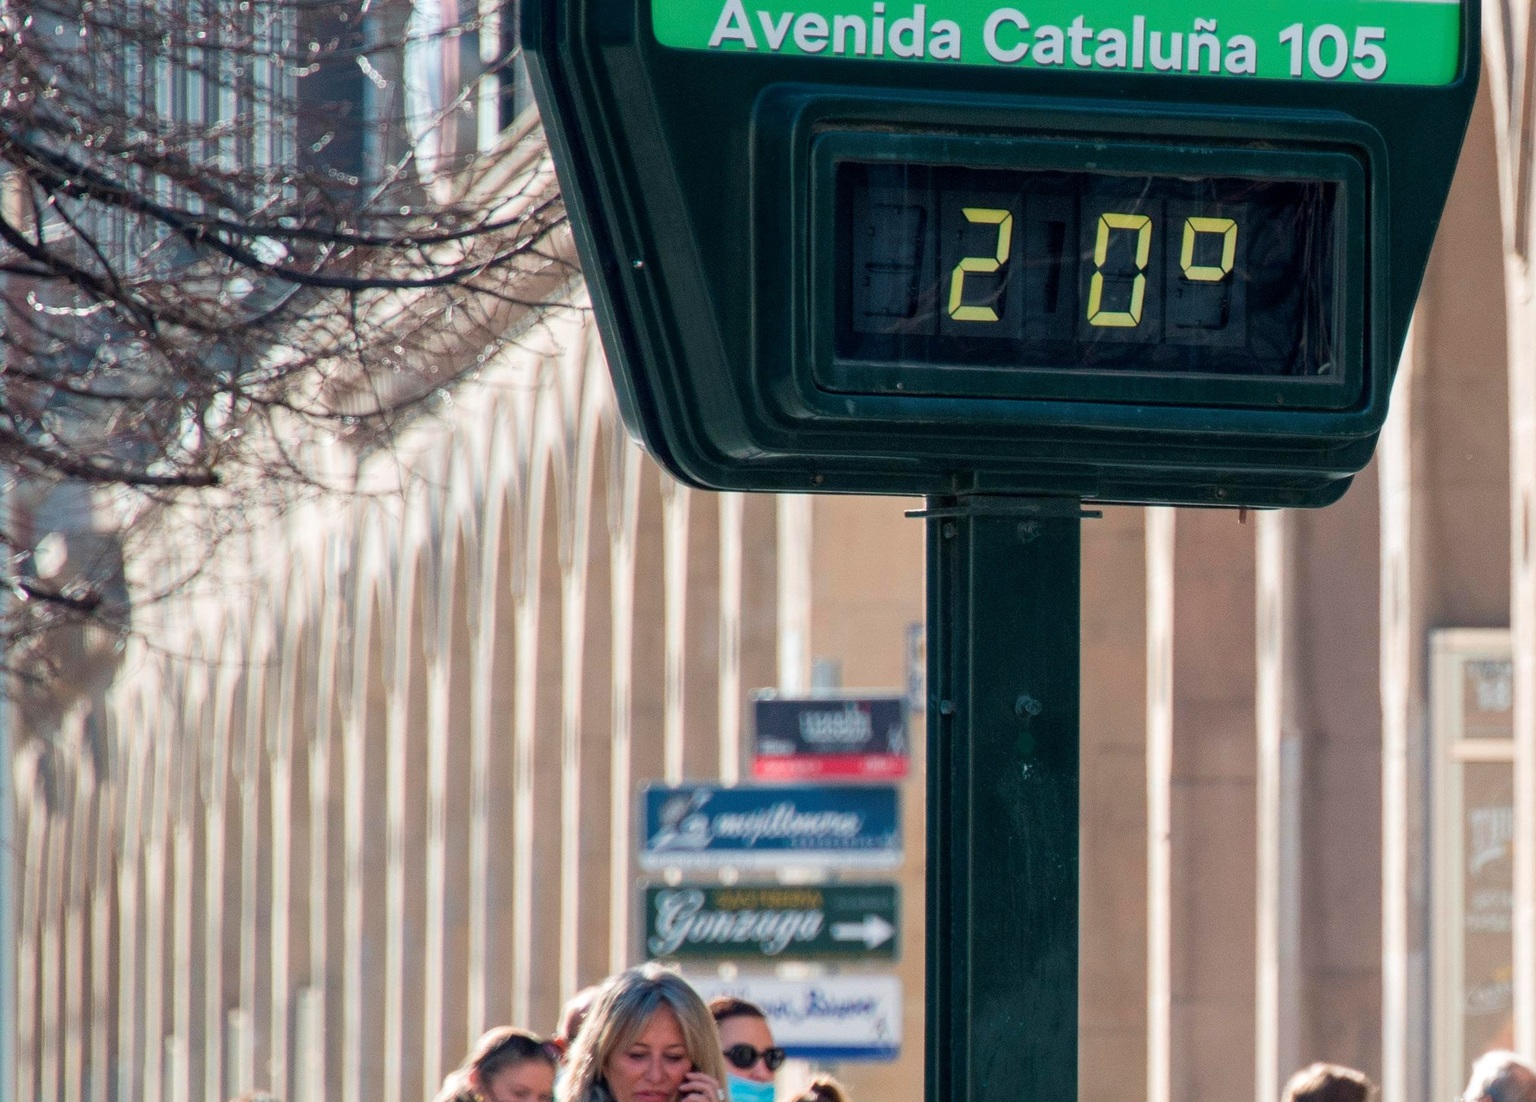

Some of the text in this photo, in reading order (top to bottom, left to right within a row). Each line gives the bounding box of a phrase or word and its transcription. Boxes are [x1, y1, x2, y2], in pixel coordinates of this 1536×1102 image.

[708, 0, 1388, 80] Avenida Cataluña 105
